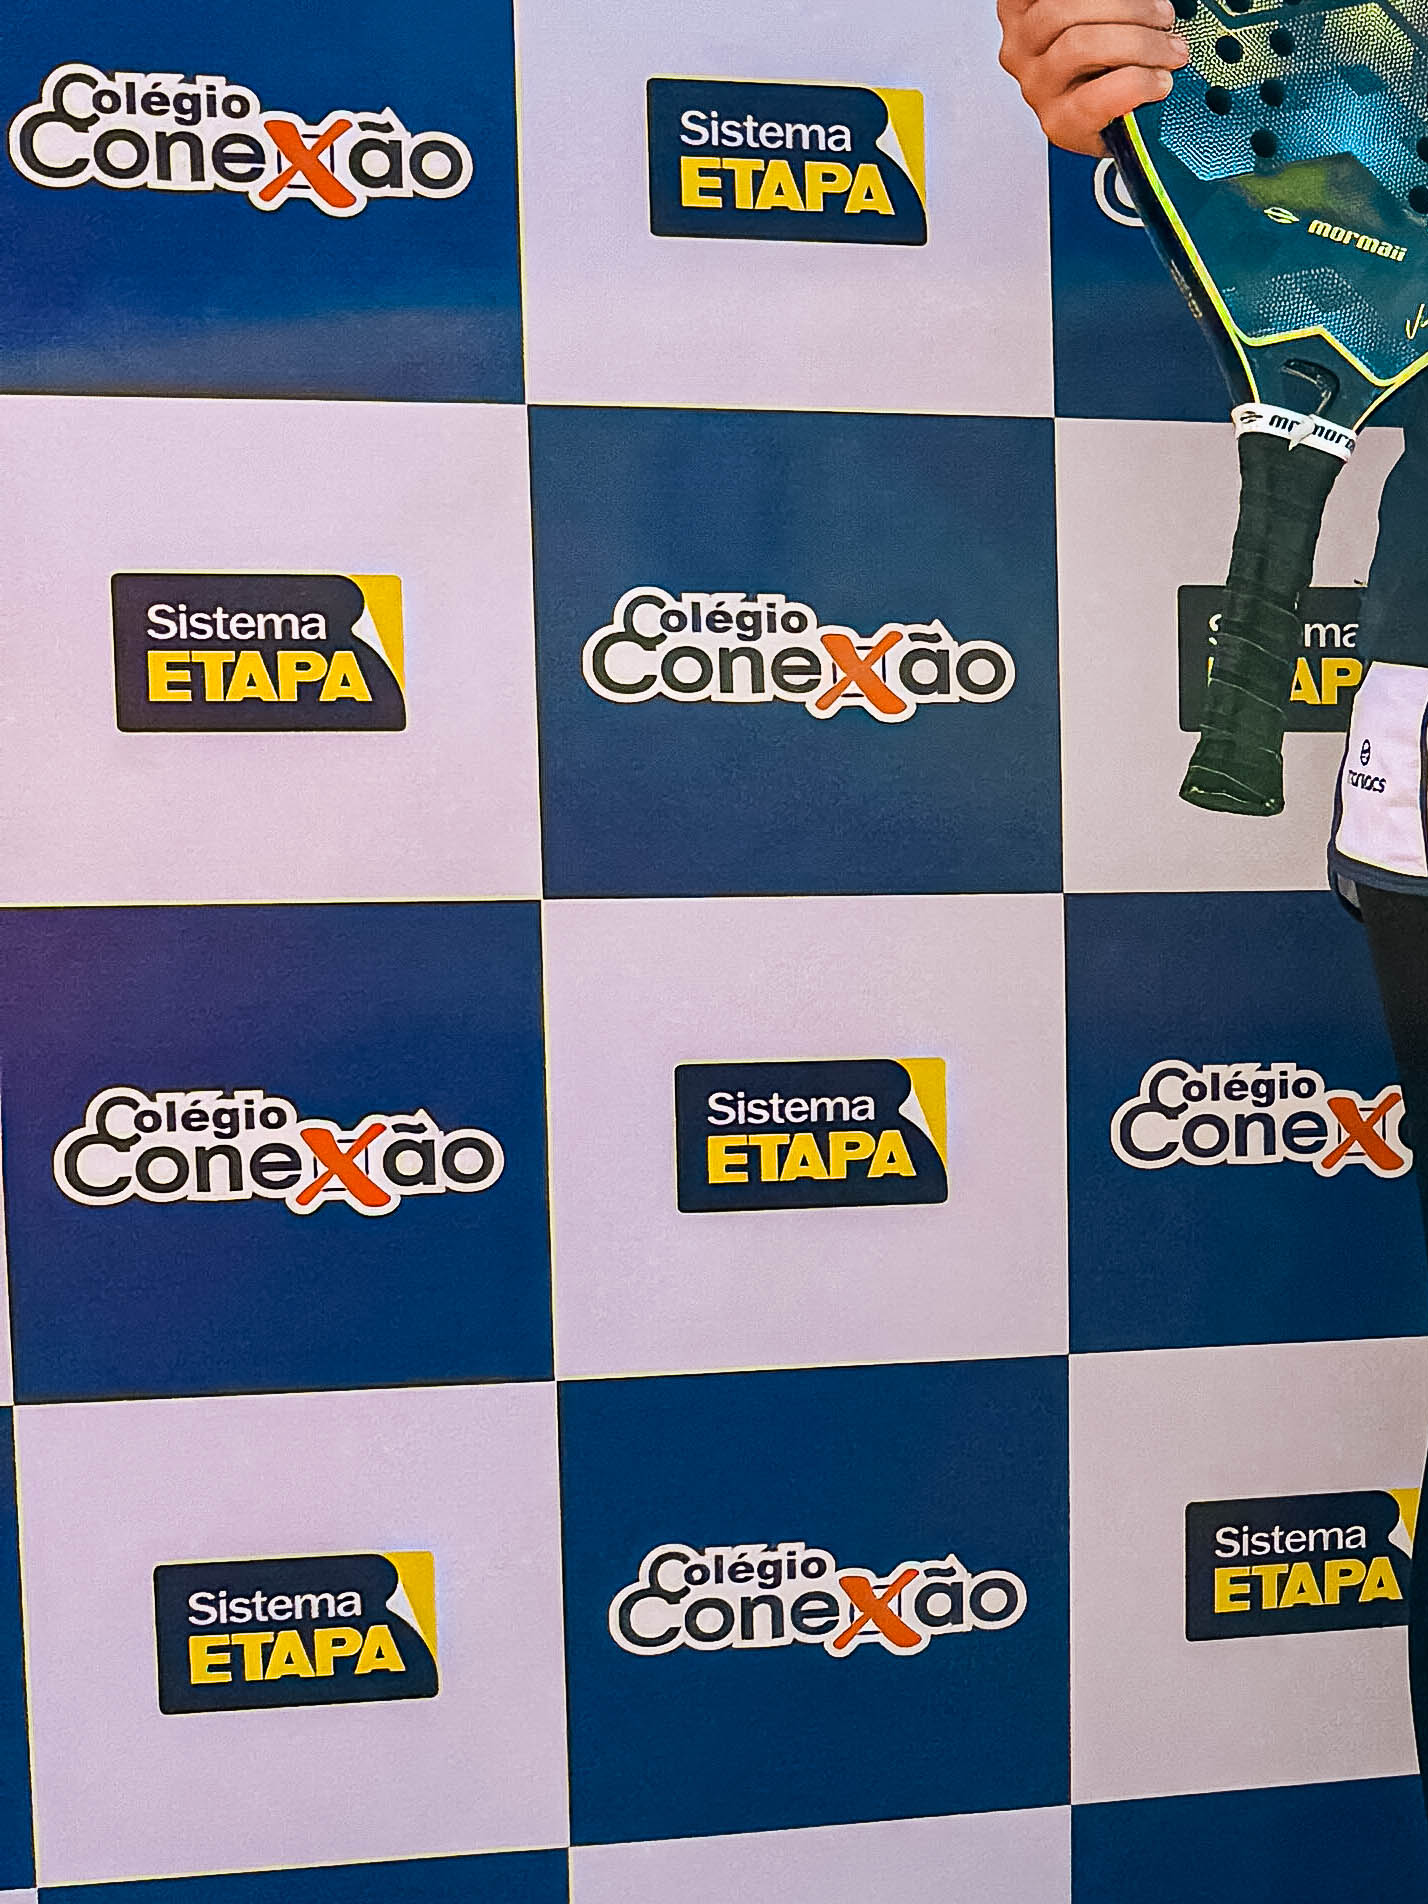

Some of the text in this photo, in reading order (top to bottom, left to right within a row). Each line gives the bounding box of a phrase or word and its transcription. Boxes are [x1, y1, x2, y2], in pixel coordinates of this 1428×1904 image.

[53, 71, 251, 129] Colégio
[680, 110, 851, 154] Sistema
[681, 155, 895, 215] ETAPA
[1308, 219, 1407, 261] mormaii
[146, 603, 326, 641] Sistema
[624, 594, 807, 647] Colégio
[148, 649, 372, 703] ETAPA
[706, 1090, 876, 1126] Sistema
[1148, 1065, 1317, 1107] Colégio
[98, 1094, 287, 1147] Colégio
[1119, 1093, 1405, 1169] ConeX
[707, 1130, 916, 1183] ETAPA
[1214, 1519, 1367, 1558] Sistema
[649, 1551, 826, 1595] Colégio
[1214, 1561, 1403, 1614] ETAPA
[188, 1586, 362, 1623] Sistema
[188, 1624, 405, 1683] ETAPA
